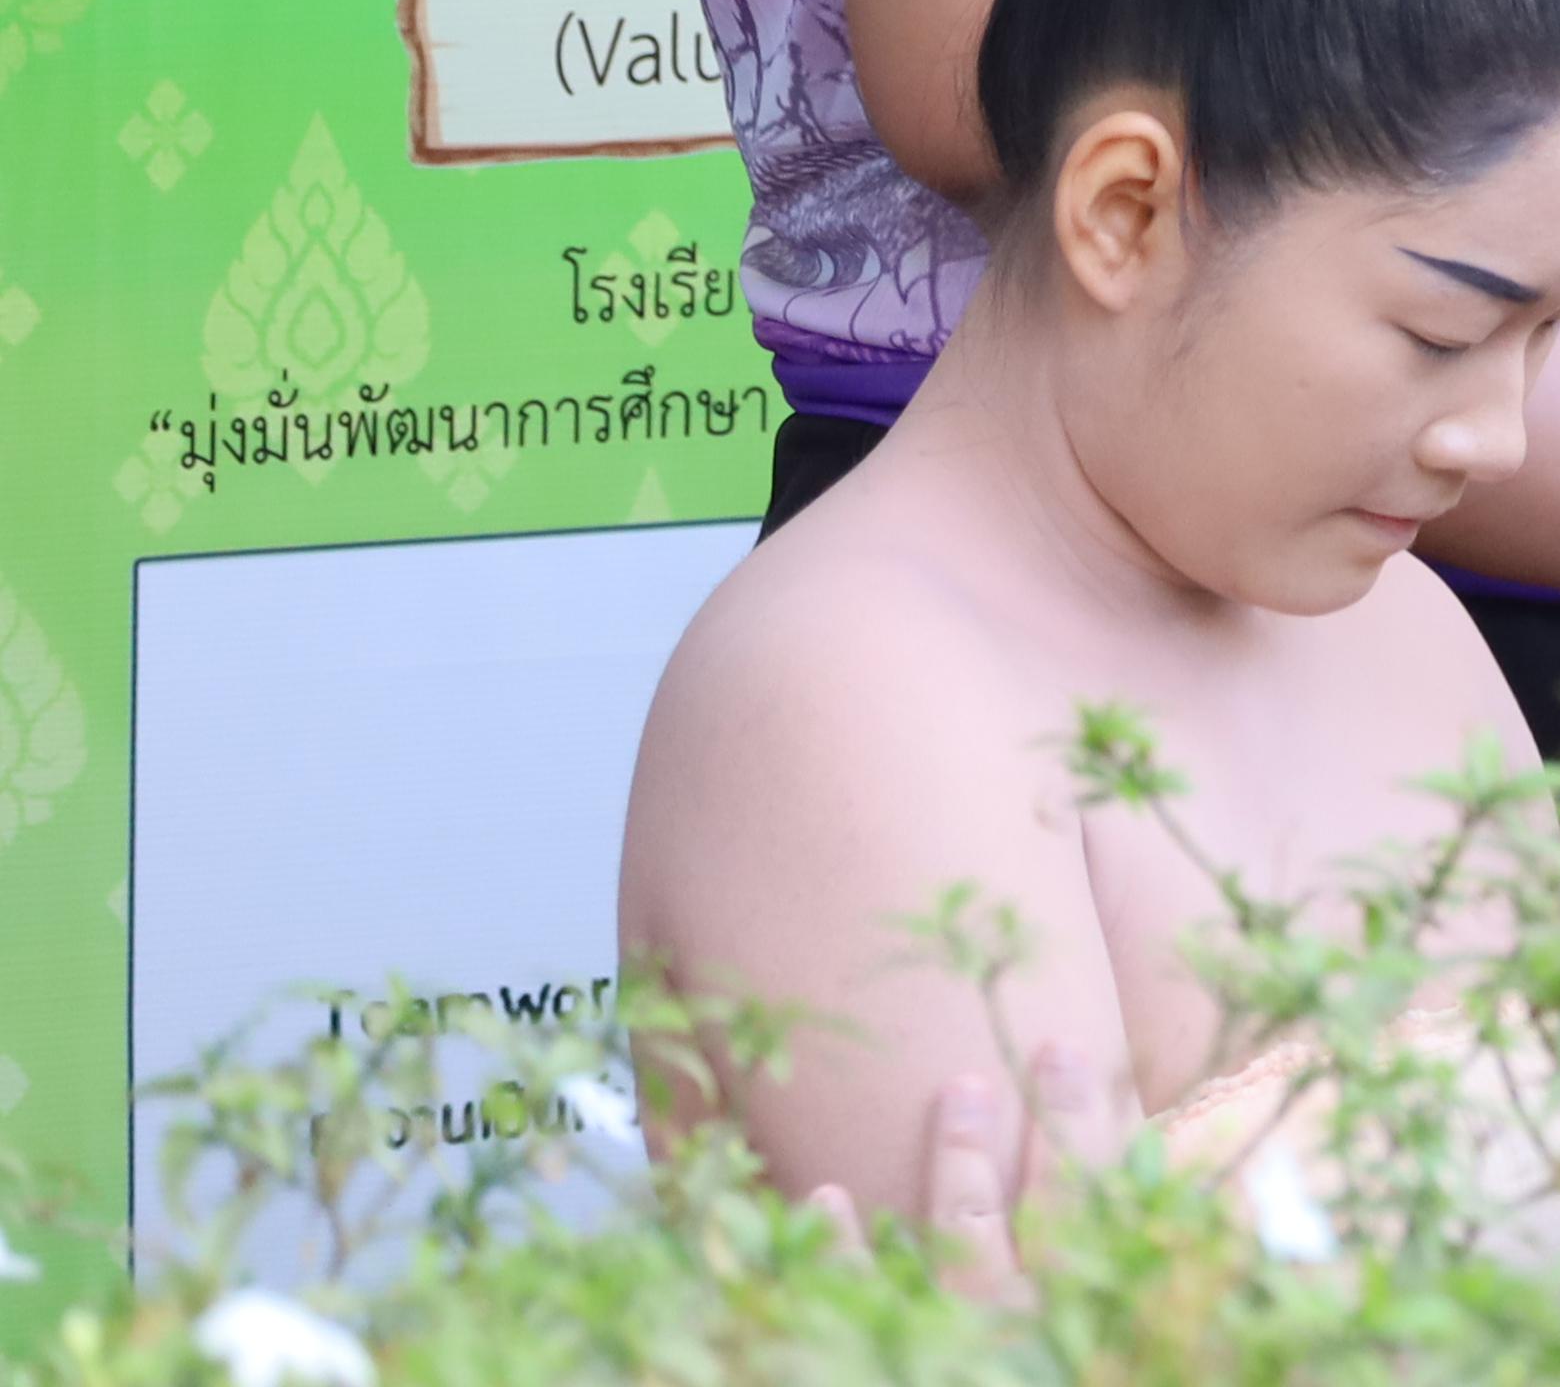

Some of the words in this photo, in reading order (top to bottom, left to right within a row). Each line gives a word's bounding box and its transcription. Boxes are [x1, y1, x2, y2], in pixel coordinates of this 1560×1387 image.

[553, 9, 722, 95] (Valu
[562, 242, 737, 324] โรงเรีย
